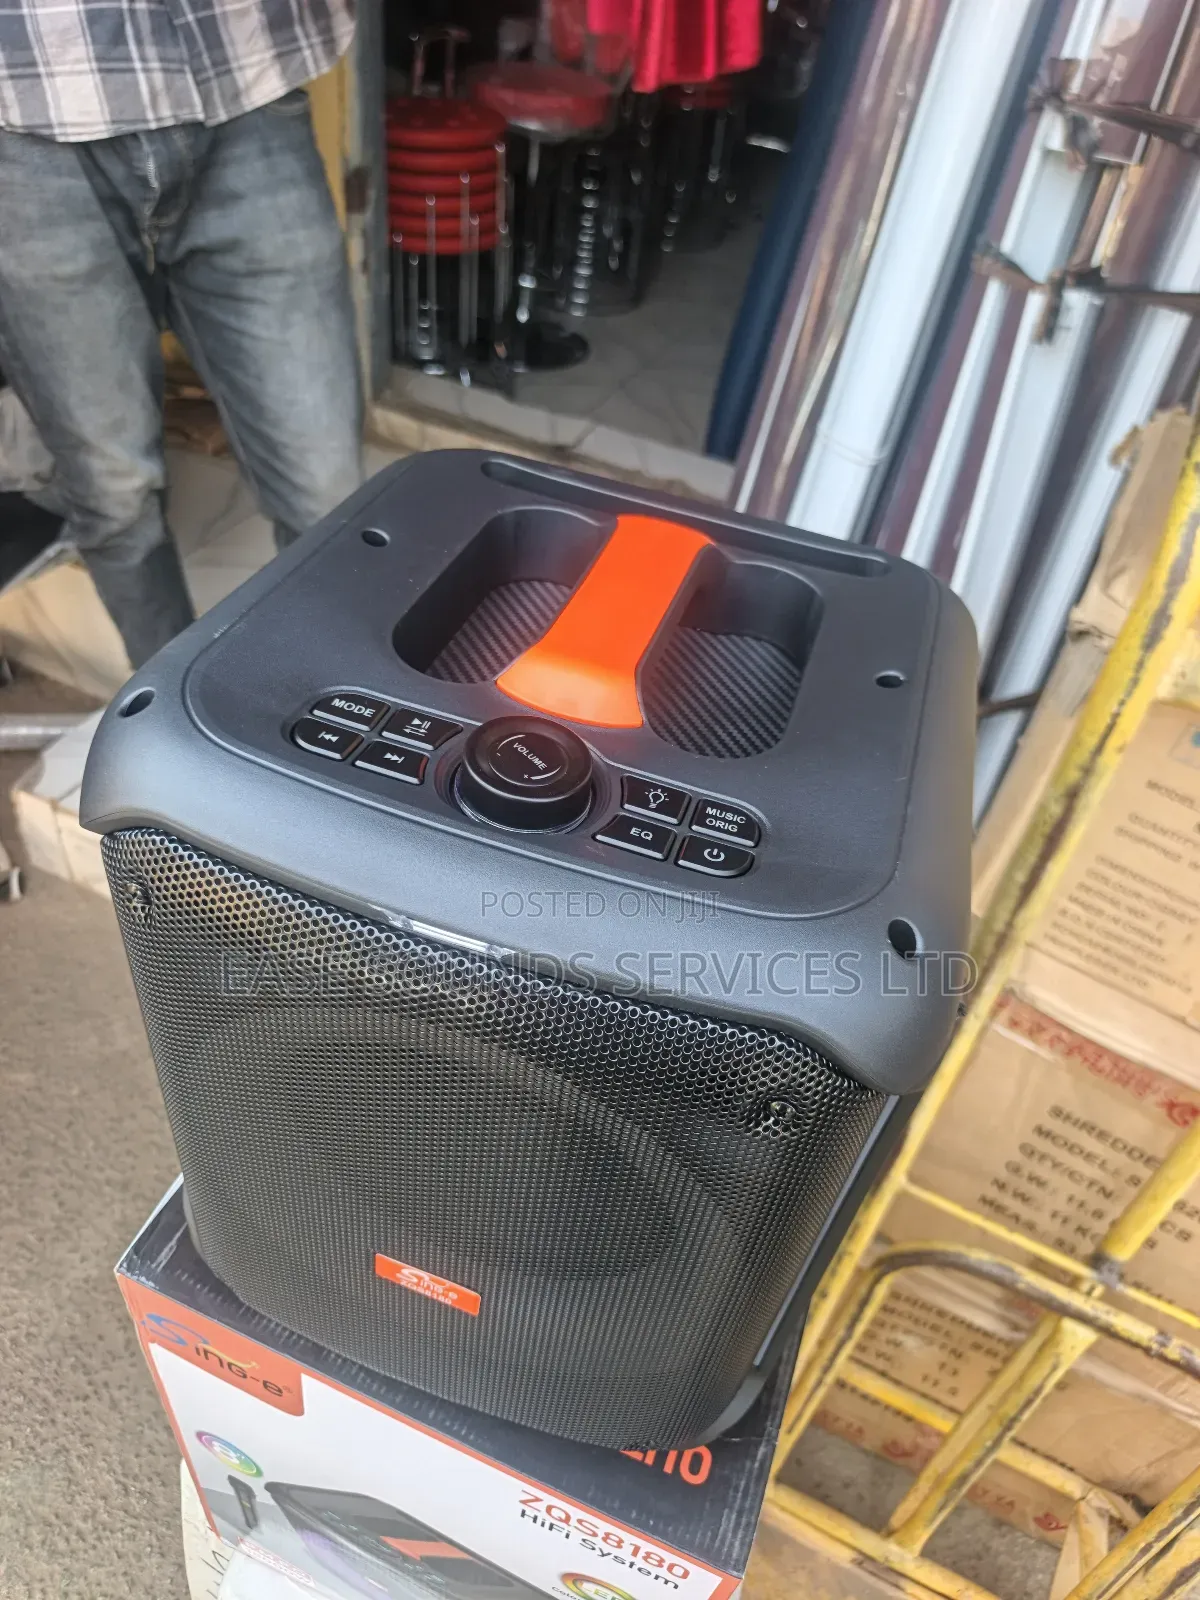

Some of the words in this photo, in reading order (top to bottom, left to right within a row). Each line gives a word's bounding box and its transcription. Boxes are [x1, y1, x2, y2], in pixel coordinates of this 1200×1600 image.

[331, 698, 377, 718] MODE
[512, 742, 548, 771] VOLUME
[705, 817, 738, 833] ORIG
[706, 806, 747, 824] MUSIC
[629, 826, 653, 841] EQ
[518, 1489, 692, 1581] ZQS8180
[519, 1508, 571, 1541] HiFi
[578, 1537, 679, 1590] System
